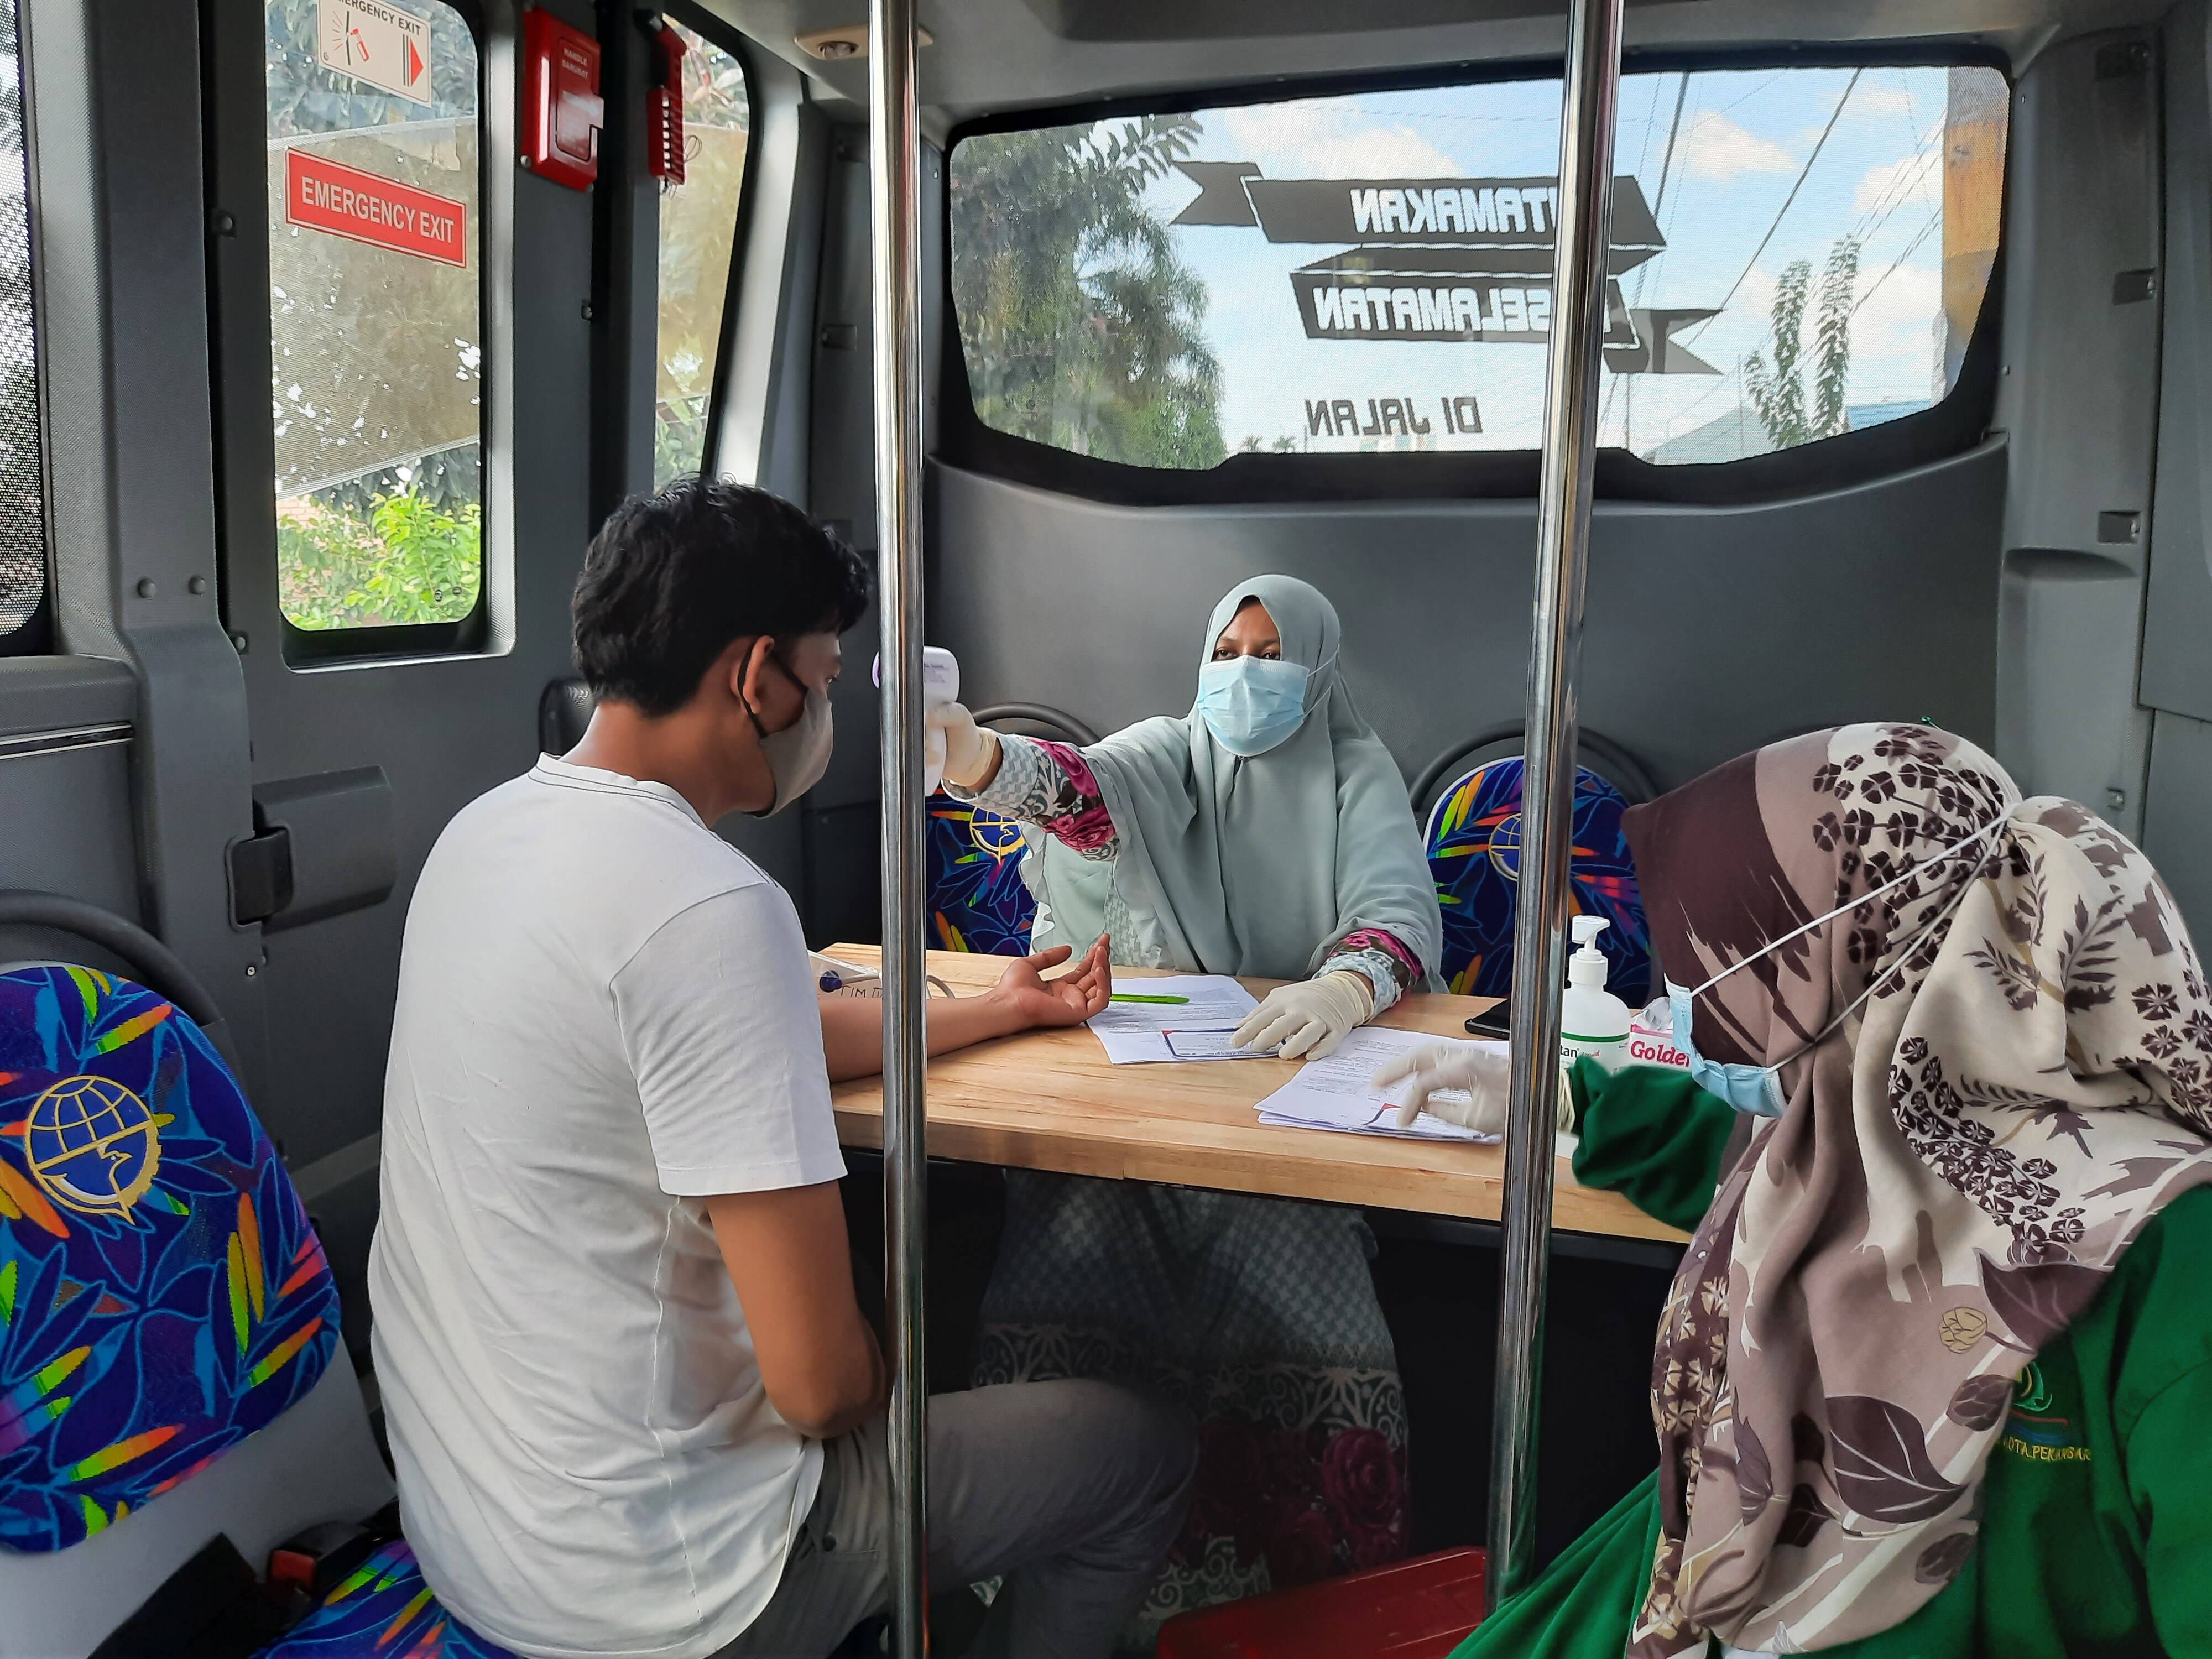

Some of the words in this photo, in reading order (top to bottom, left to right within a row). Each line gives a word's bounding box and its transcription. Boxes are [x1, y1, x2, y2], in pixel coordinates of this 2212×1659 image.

[398, 17, 421, 35] EXIT
[301, 176, 416, 233] EMERGENCY
[420, 211, 455, 244] EXIT
